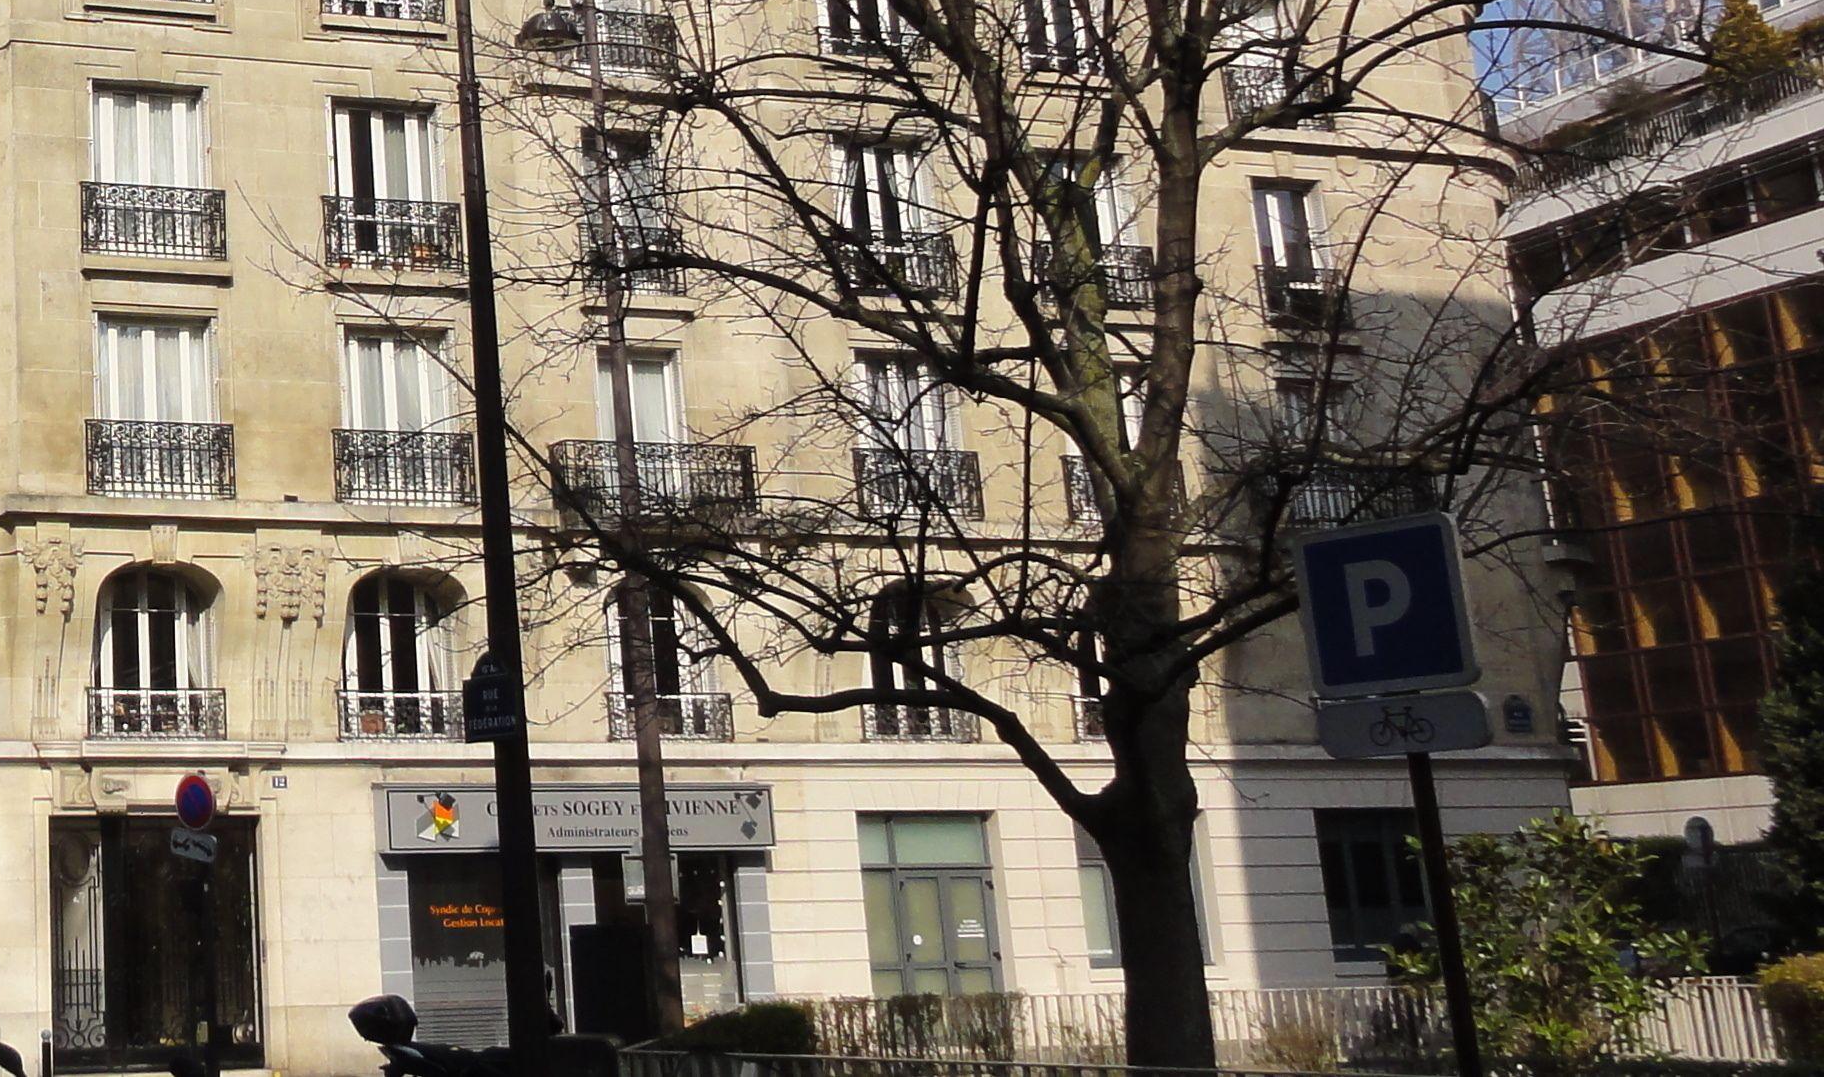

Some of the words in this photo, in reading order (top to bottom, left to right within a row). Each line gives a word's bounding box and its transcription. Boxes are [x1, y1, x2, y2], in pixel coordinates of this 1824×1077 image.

[1343, 559, 1411, 657] P
[483, 688, 499, 700] RUE
[562, 800, 624, 816] SOGEY
[548, 826, 639, 838] Administrateurs
[429, 904, 459, 916] Syndic
[461, 904, 473, 914] de
[443, 918, 478, 928] Gestion
